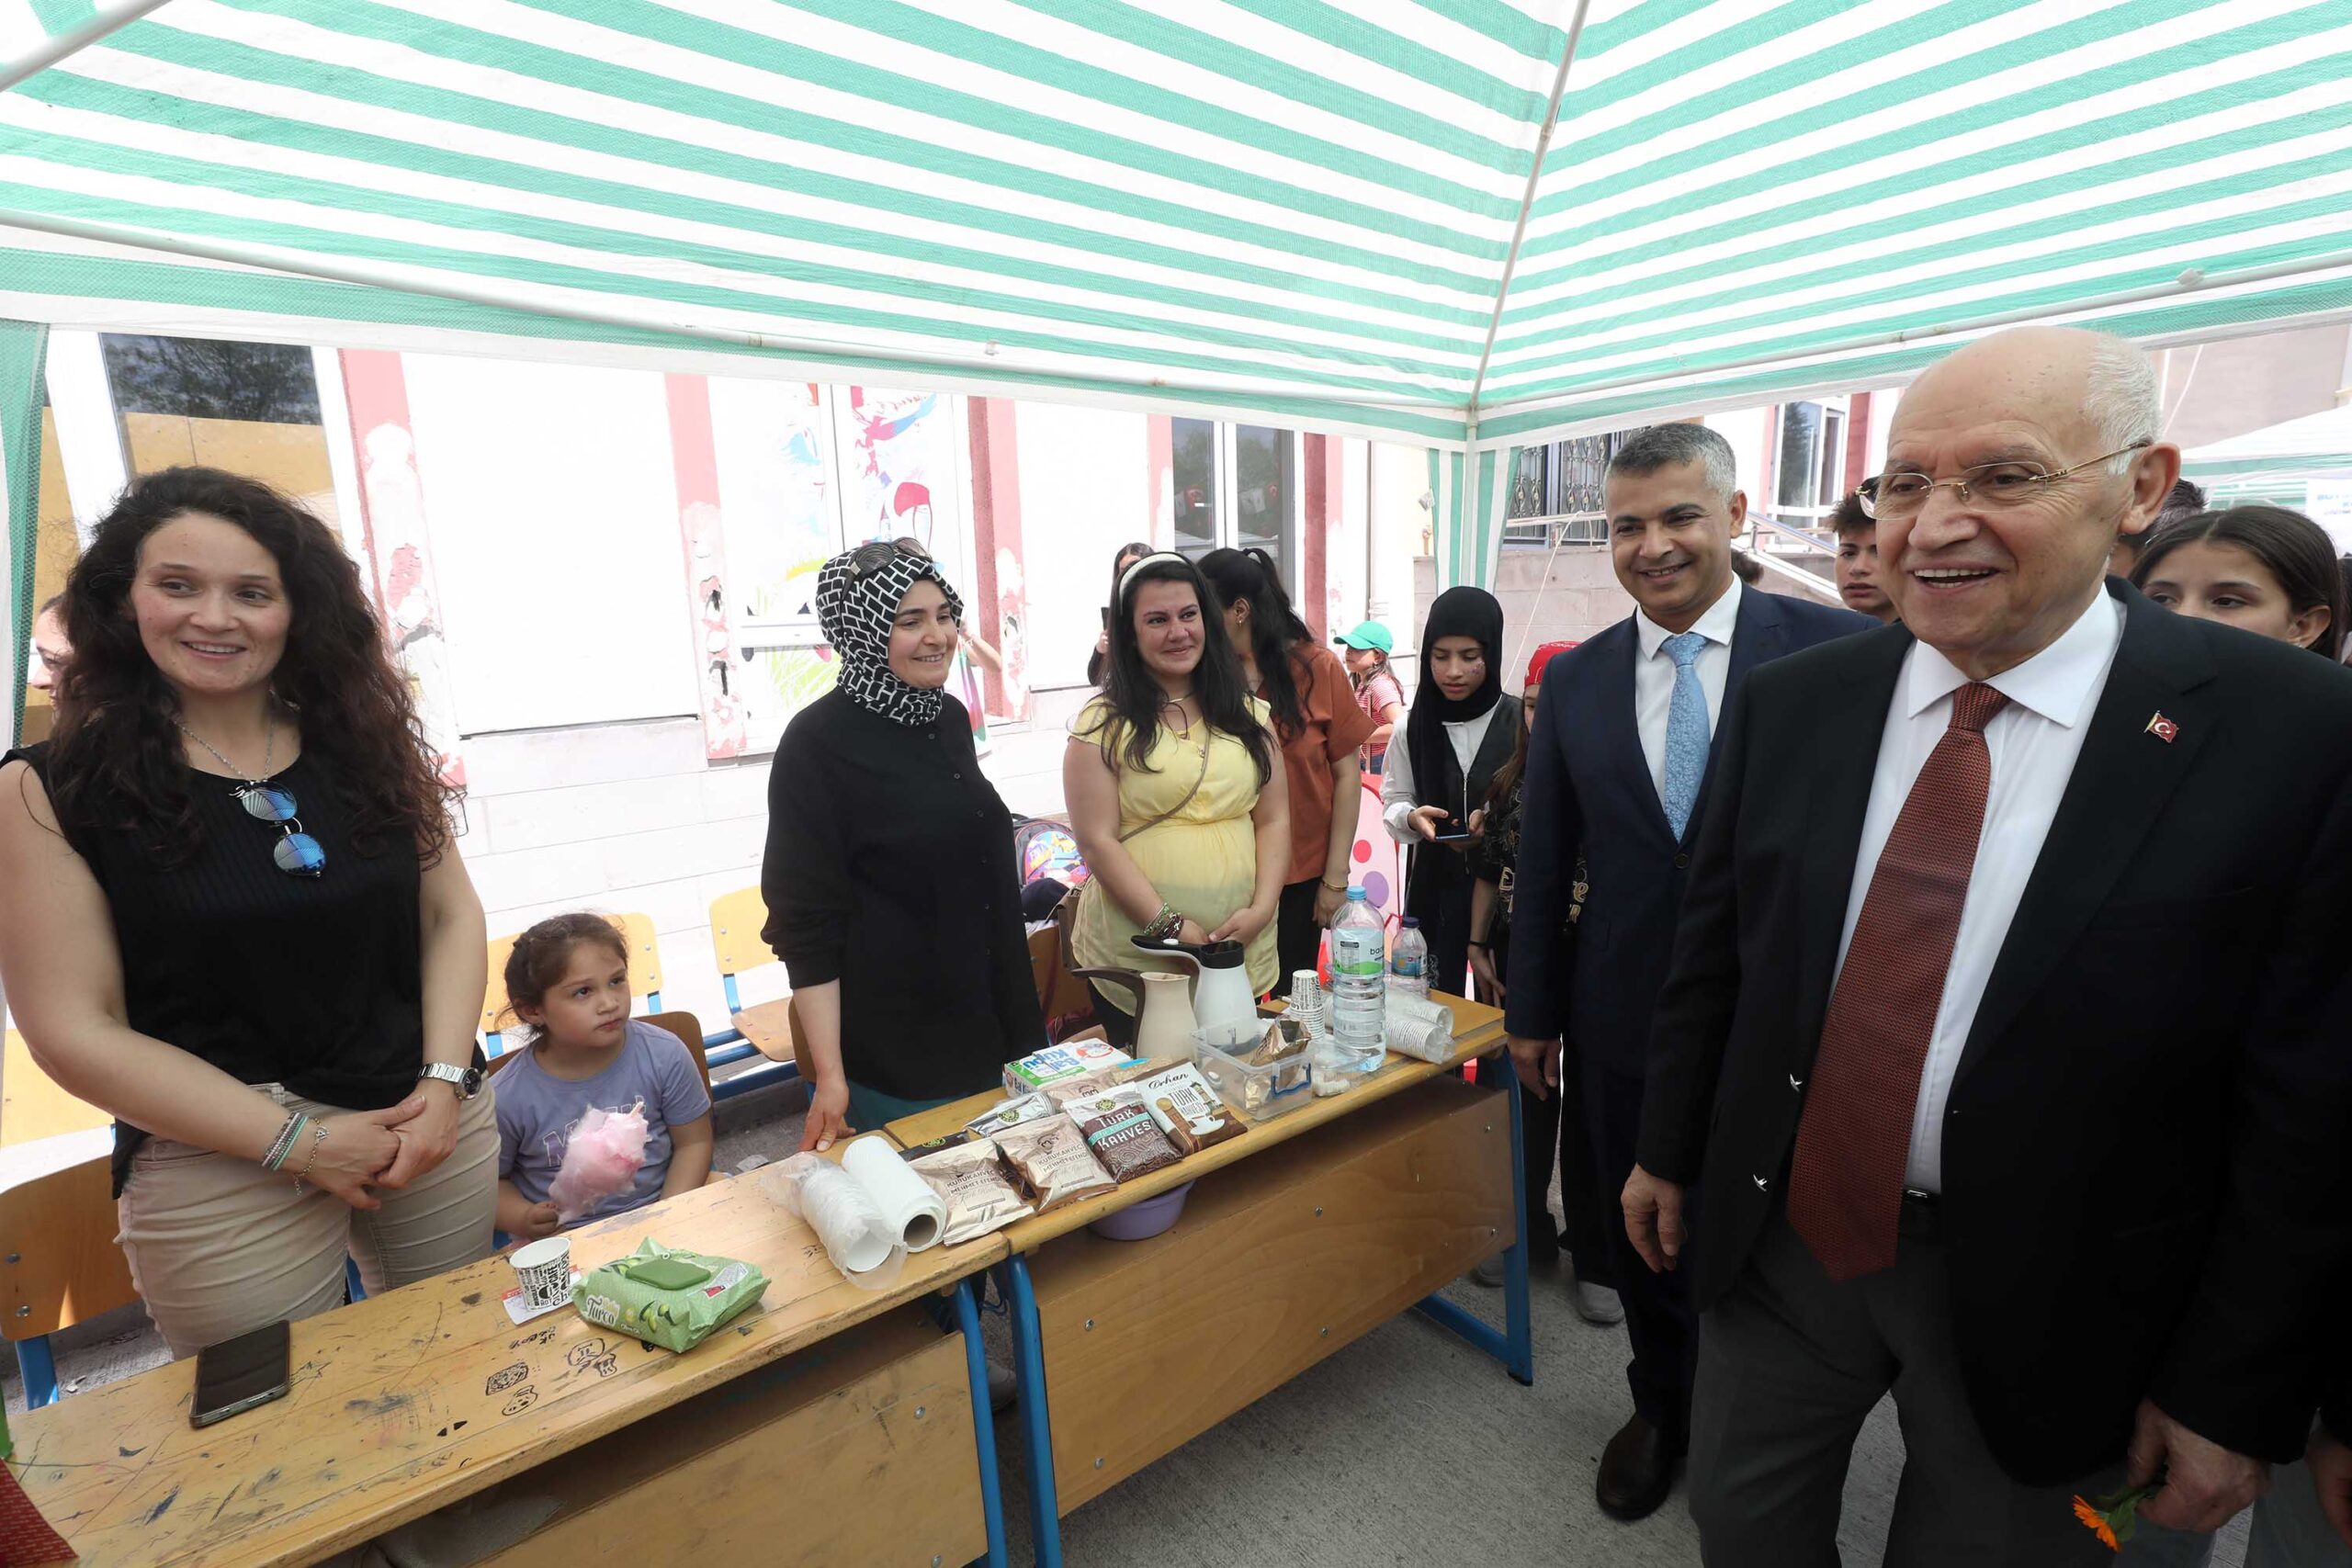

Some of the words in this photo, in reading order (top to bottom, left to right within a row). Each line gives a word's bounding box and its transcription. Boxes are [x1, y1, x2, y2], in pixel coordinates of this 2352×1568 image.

[1148, 1073, 1189, 1089] Orhan
[950, 1180, 980, 1194] MEHMET
[587, 1297, 615, 1325] Turco
